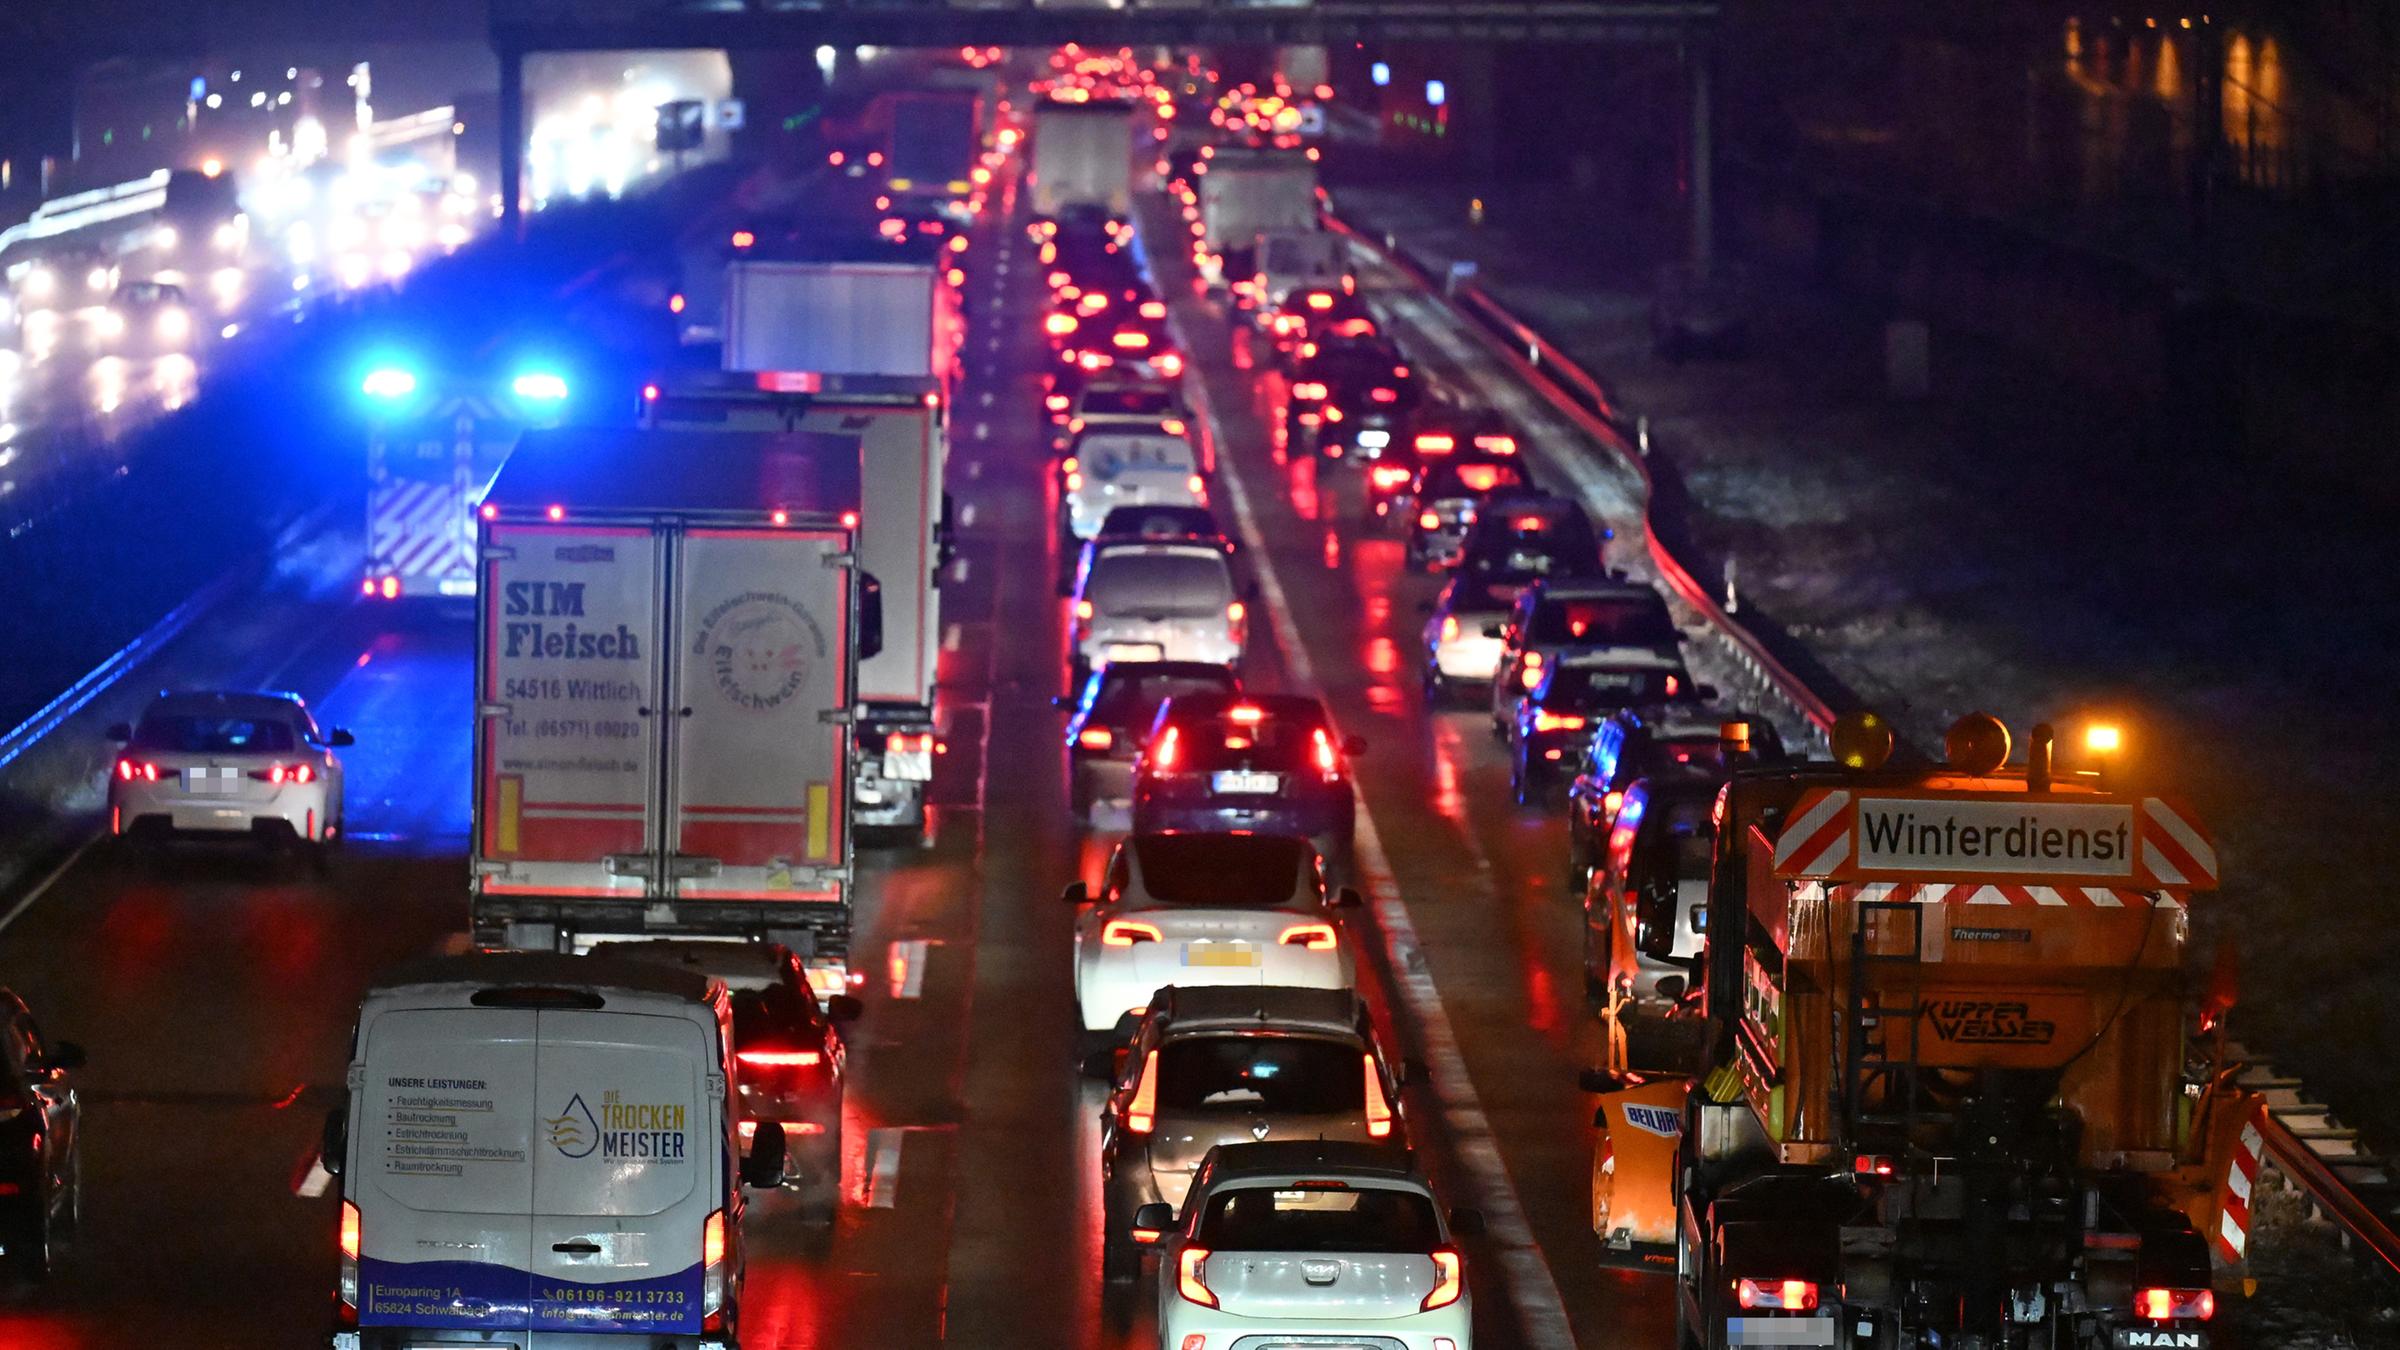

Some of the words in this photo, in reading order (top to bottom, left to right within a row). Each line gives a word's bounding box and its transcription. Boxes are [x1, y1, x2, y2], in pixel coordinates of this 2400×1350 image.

[505, 580, 586, 616] SIM
[505, 621, 641, 660] Fleisch
[505, 679, 561, 699] 54516
[567, 678, 641, 701] Wittlich
[1864, 812, 2128, 860] Winterdienst
[388, 1077, 425, 1089] UNSERE
[427, 1079, 487, 1090] LEISTUNGEN:
[603, 1090, 620, 1104] DIE
[396, 1112, 456, 1125] Bautrocknung
[601, 1104, 685, 1130] TROCKEN
[603, 1132, 685, 1158] MEISTER
[375, 1285, 441, 1300] Europaring
[446, 1288, 462, 1298] 1A
[556, 1289, 684, 1304] 06196-9213733
[375, 1302, 412, 1314] 65824
[2129, 1332, 2199, 1348] MAN
